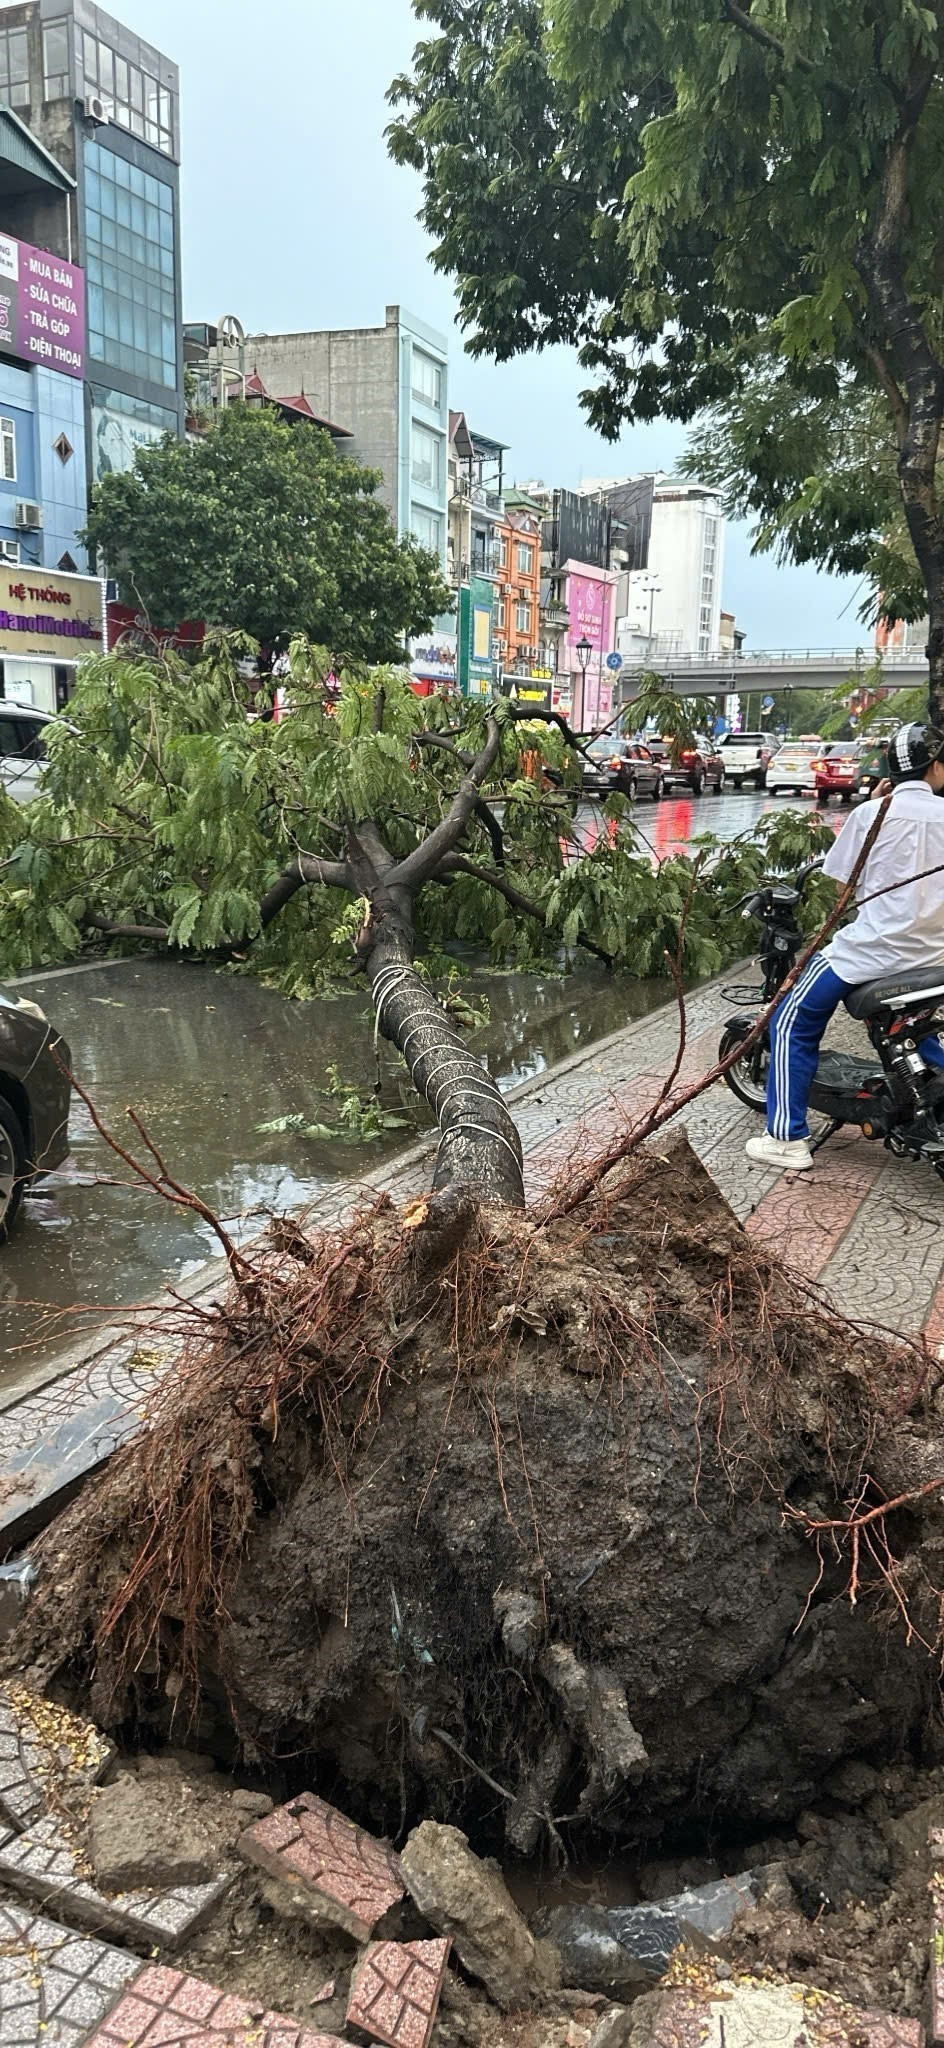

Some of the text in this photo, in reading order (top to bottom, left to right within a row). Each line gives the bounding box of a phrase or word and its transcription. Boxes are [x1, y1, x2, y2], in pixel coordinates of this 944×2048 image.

[29, 258, 52, 283] MUA
[54, 268, 73, 289] BÁN
[29, 282, 50, 305] SỬA
[51, 292, 78, 316] CHỮA
[29, 310, 48, 331] TRẢ
[51, 318, 70, 337] GÓP
[29, 336, 81, 370] ĐIỆN THOẠI
[9, 583, 72, 606] HỆ THỐNG
